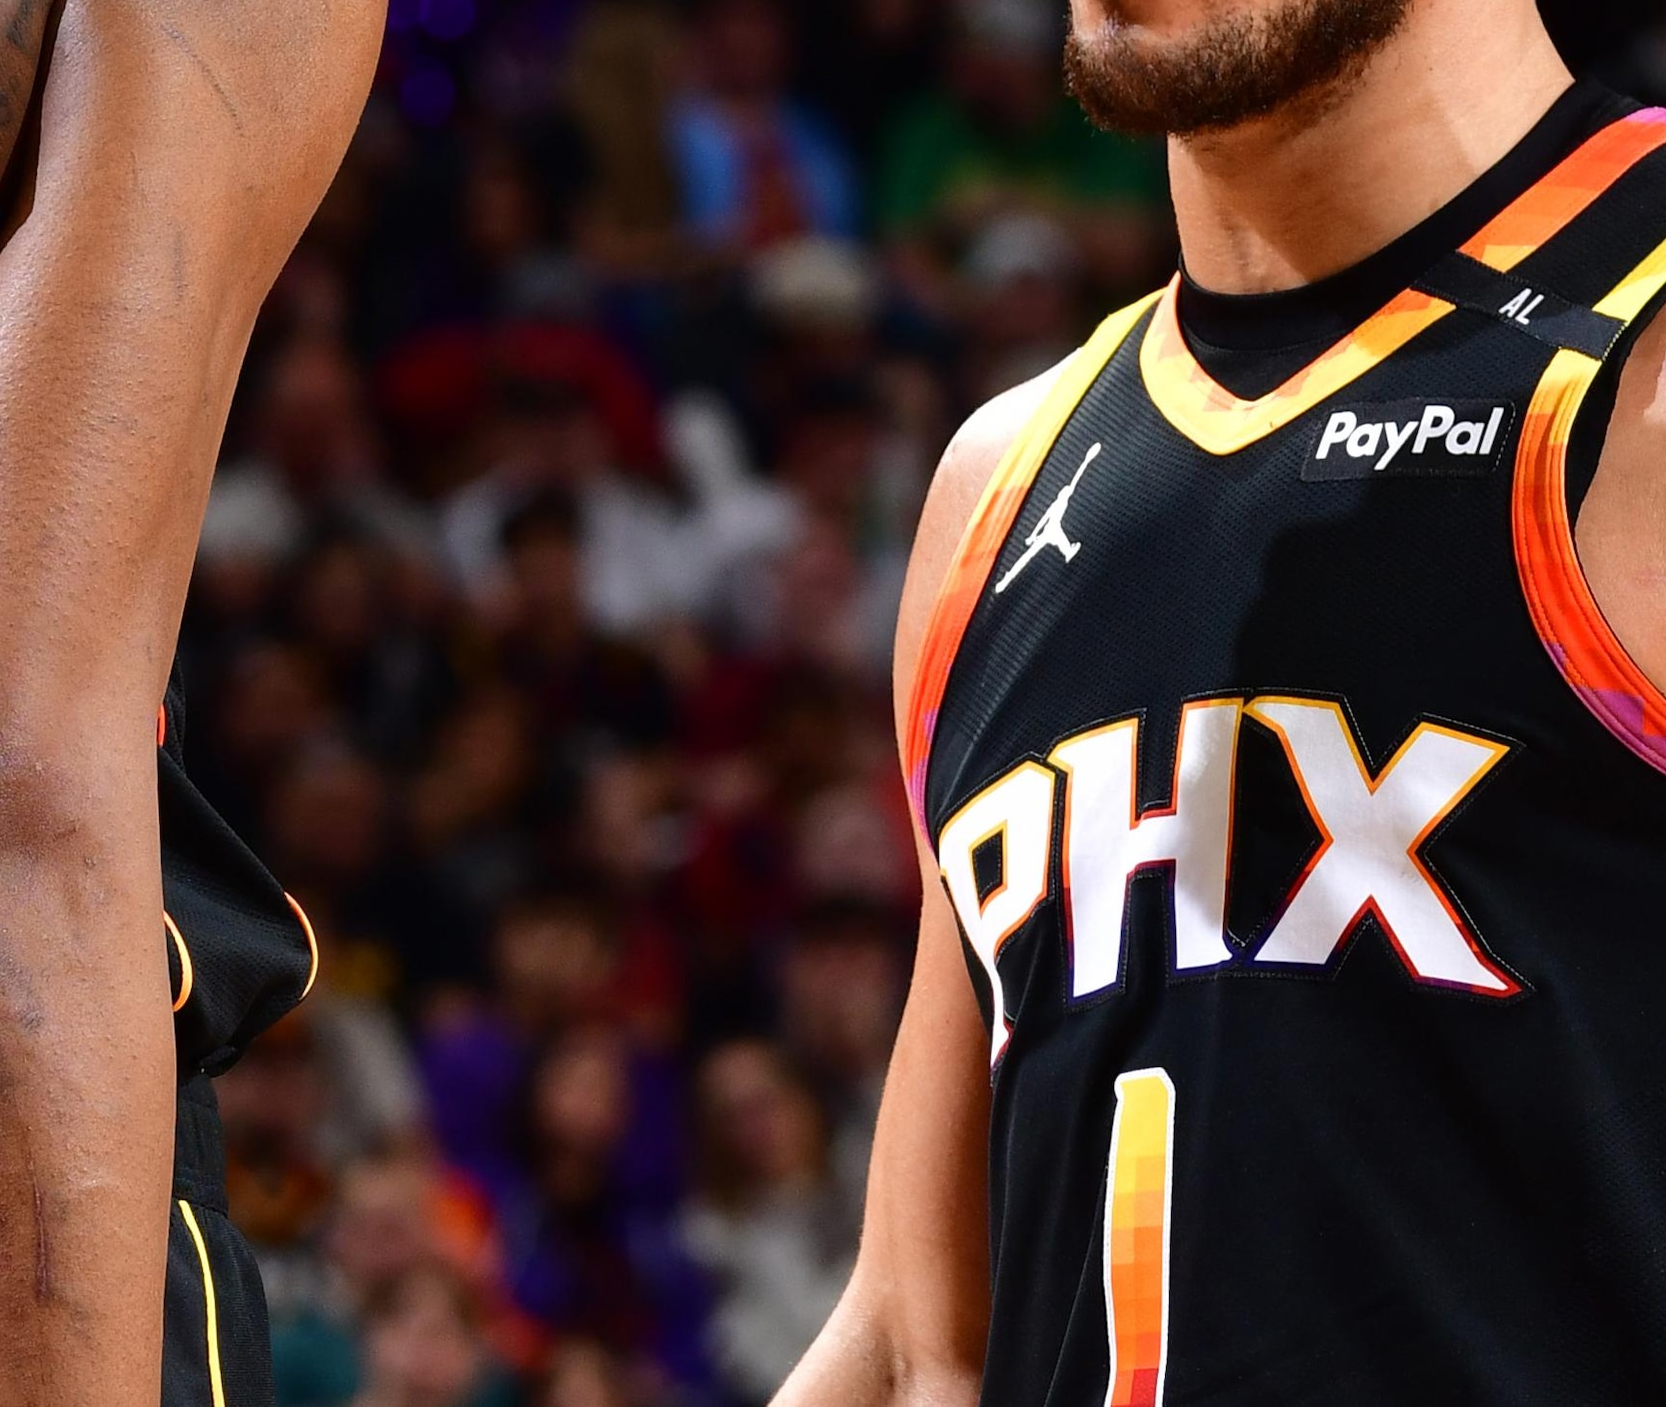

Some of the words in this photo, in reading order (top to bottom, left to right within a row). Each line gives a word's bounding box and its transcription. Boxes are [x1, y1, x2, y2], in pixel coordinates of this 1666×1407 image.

[1498, 287, 1545, 325] AL
[1315, 404, 1505, 471] PayPal
[937, 694, 1525, 1068] PHX
[1104, 1066, 1176, 1407] 1
